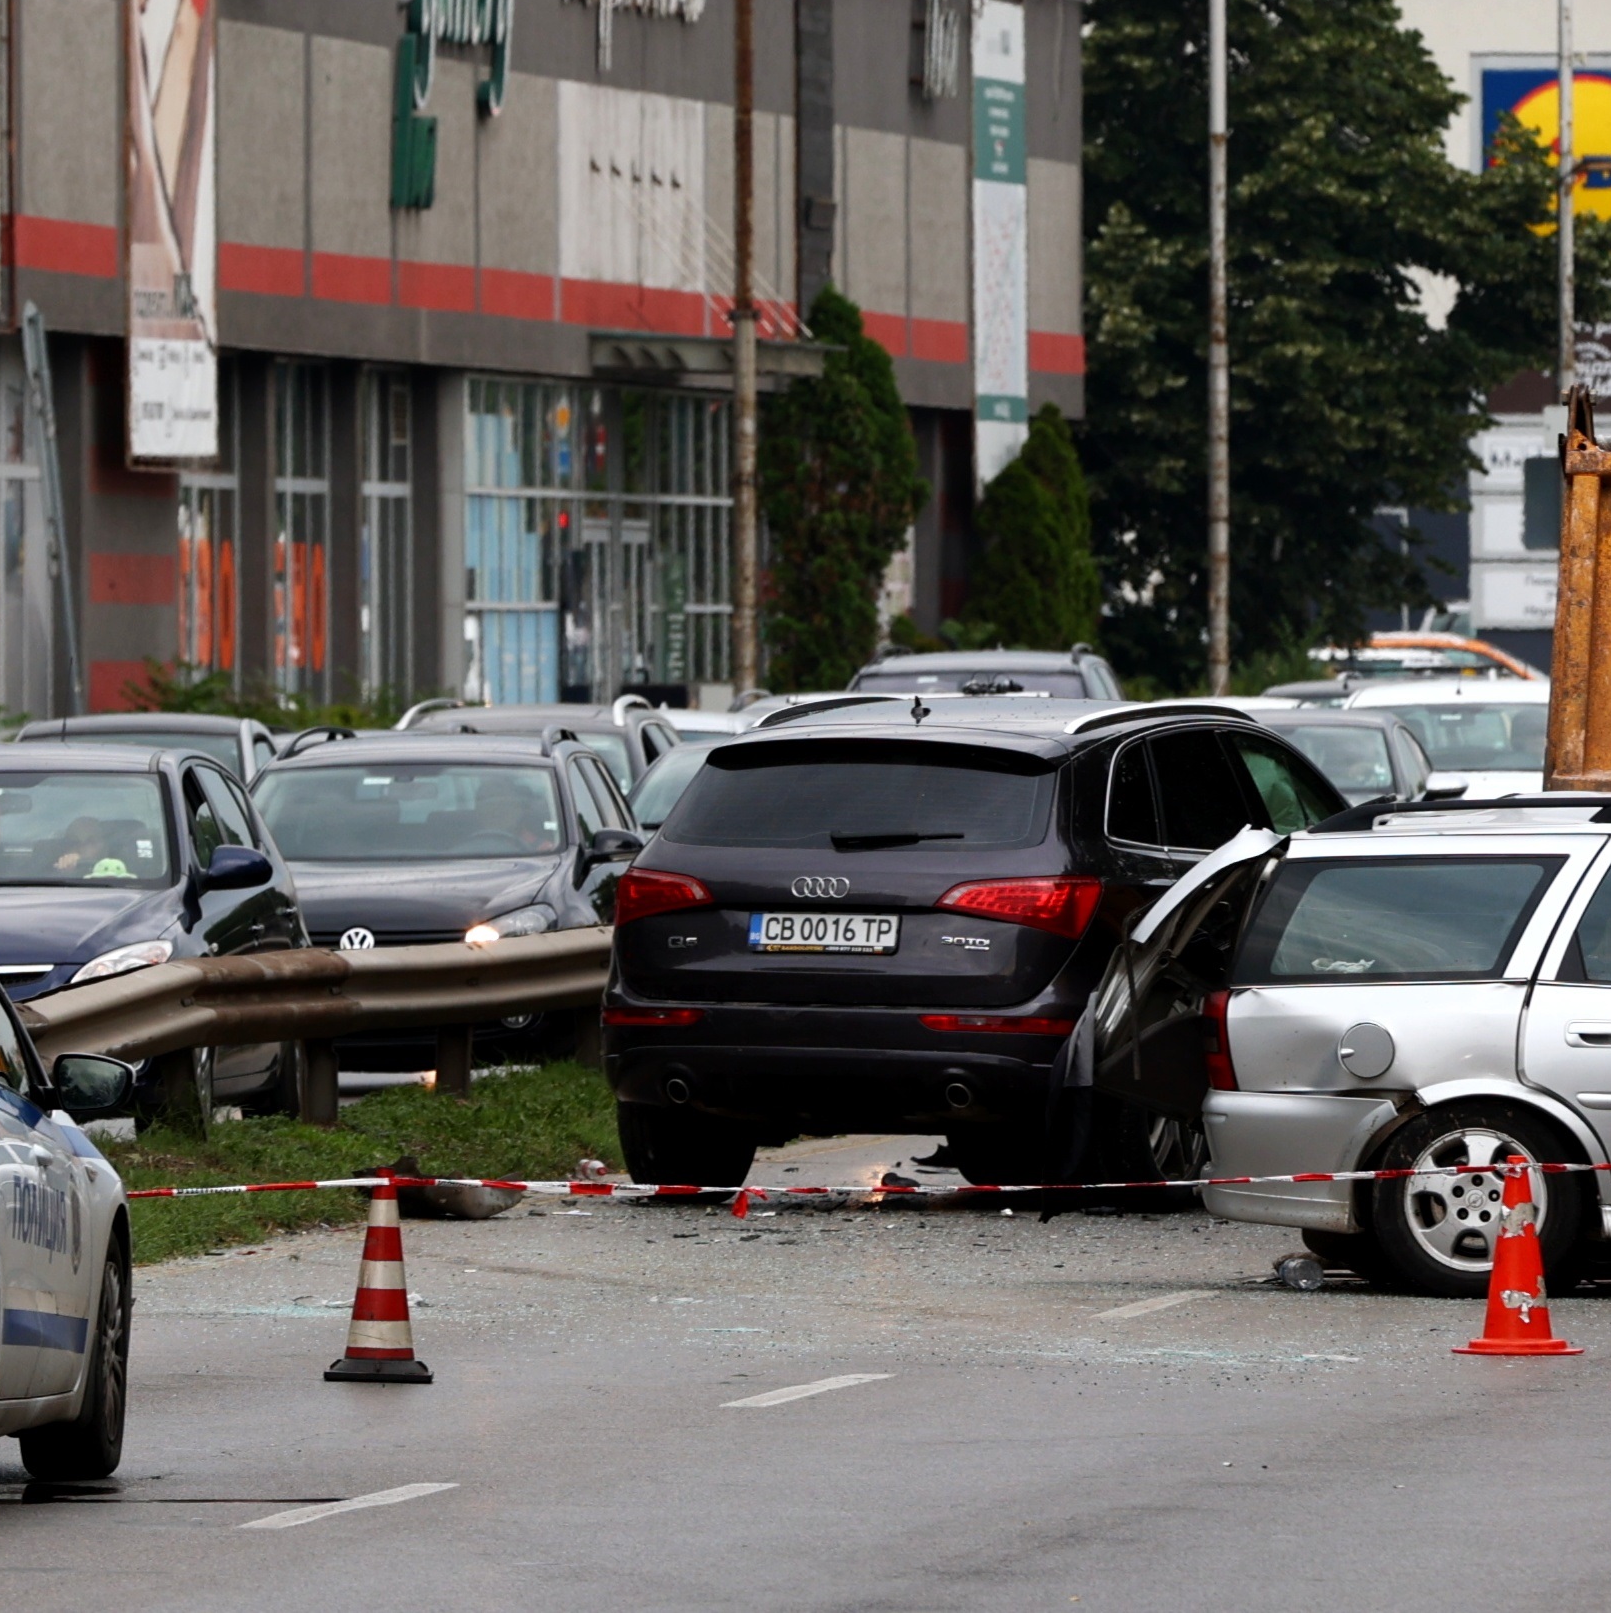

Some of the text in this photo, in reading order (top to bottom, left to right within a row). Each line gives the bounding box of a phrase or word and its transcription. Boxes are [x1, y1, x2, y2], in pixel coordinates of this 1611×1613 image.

[765, 917, 892, 943] CB 0016 TP
[12, 1174, 66, 1264] ПОЛИЦИЯ
